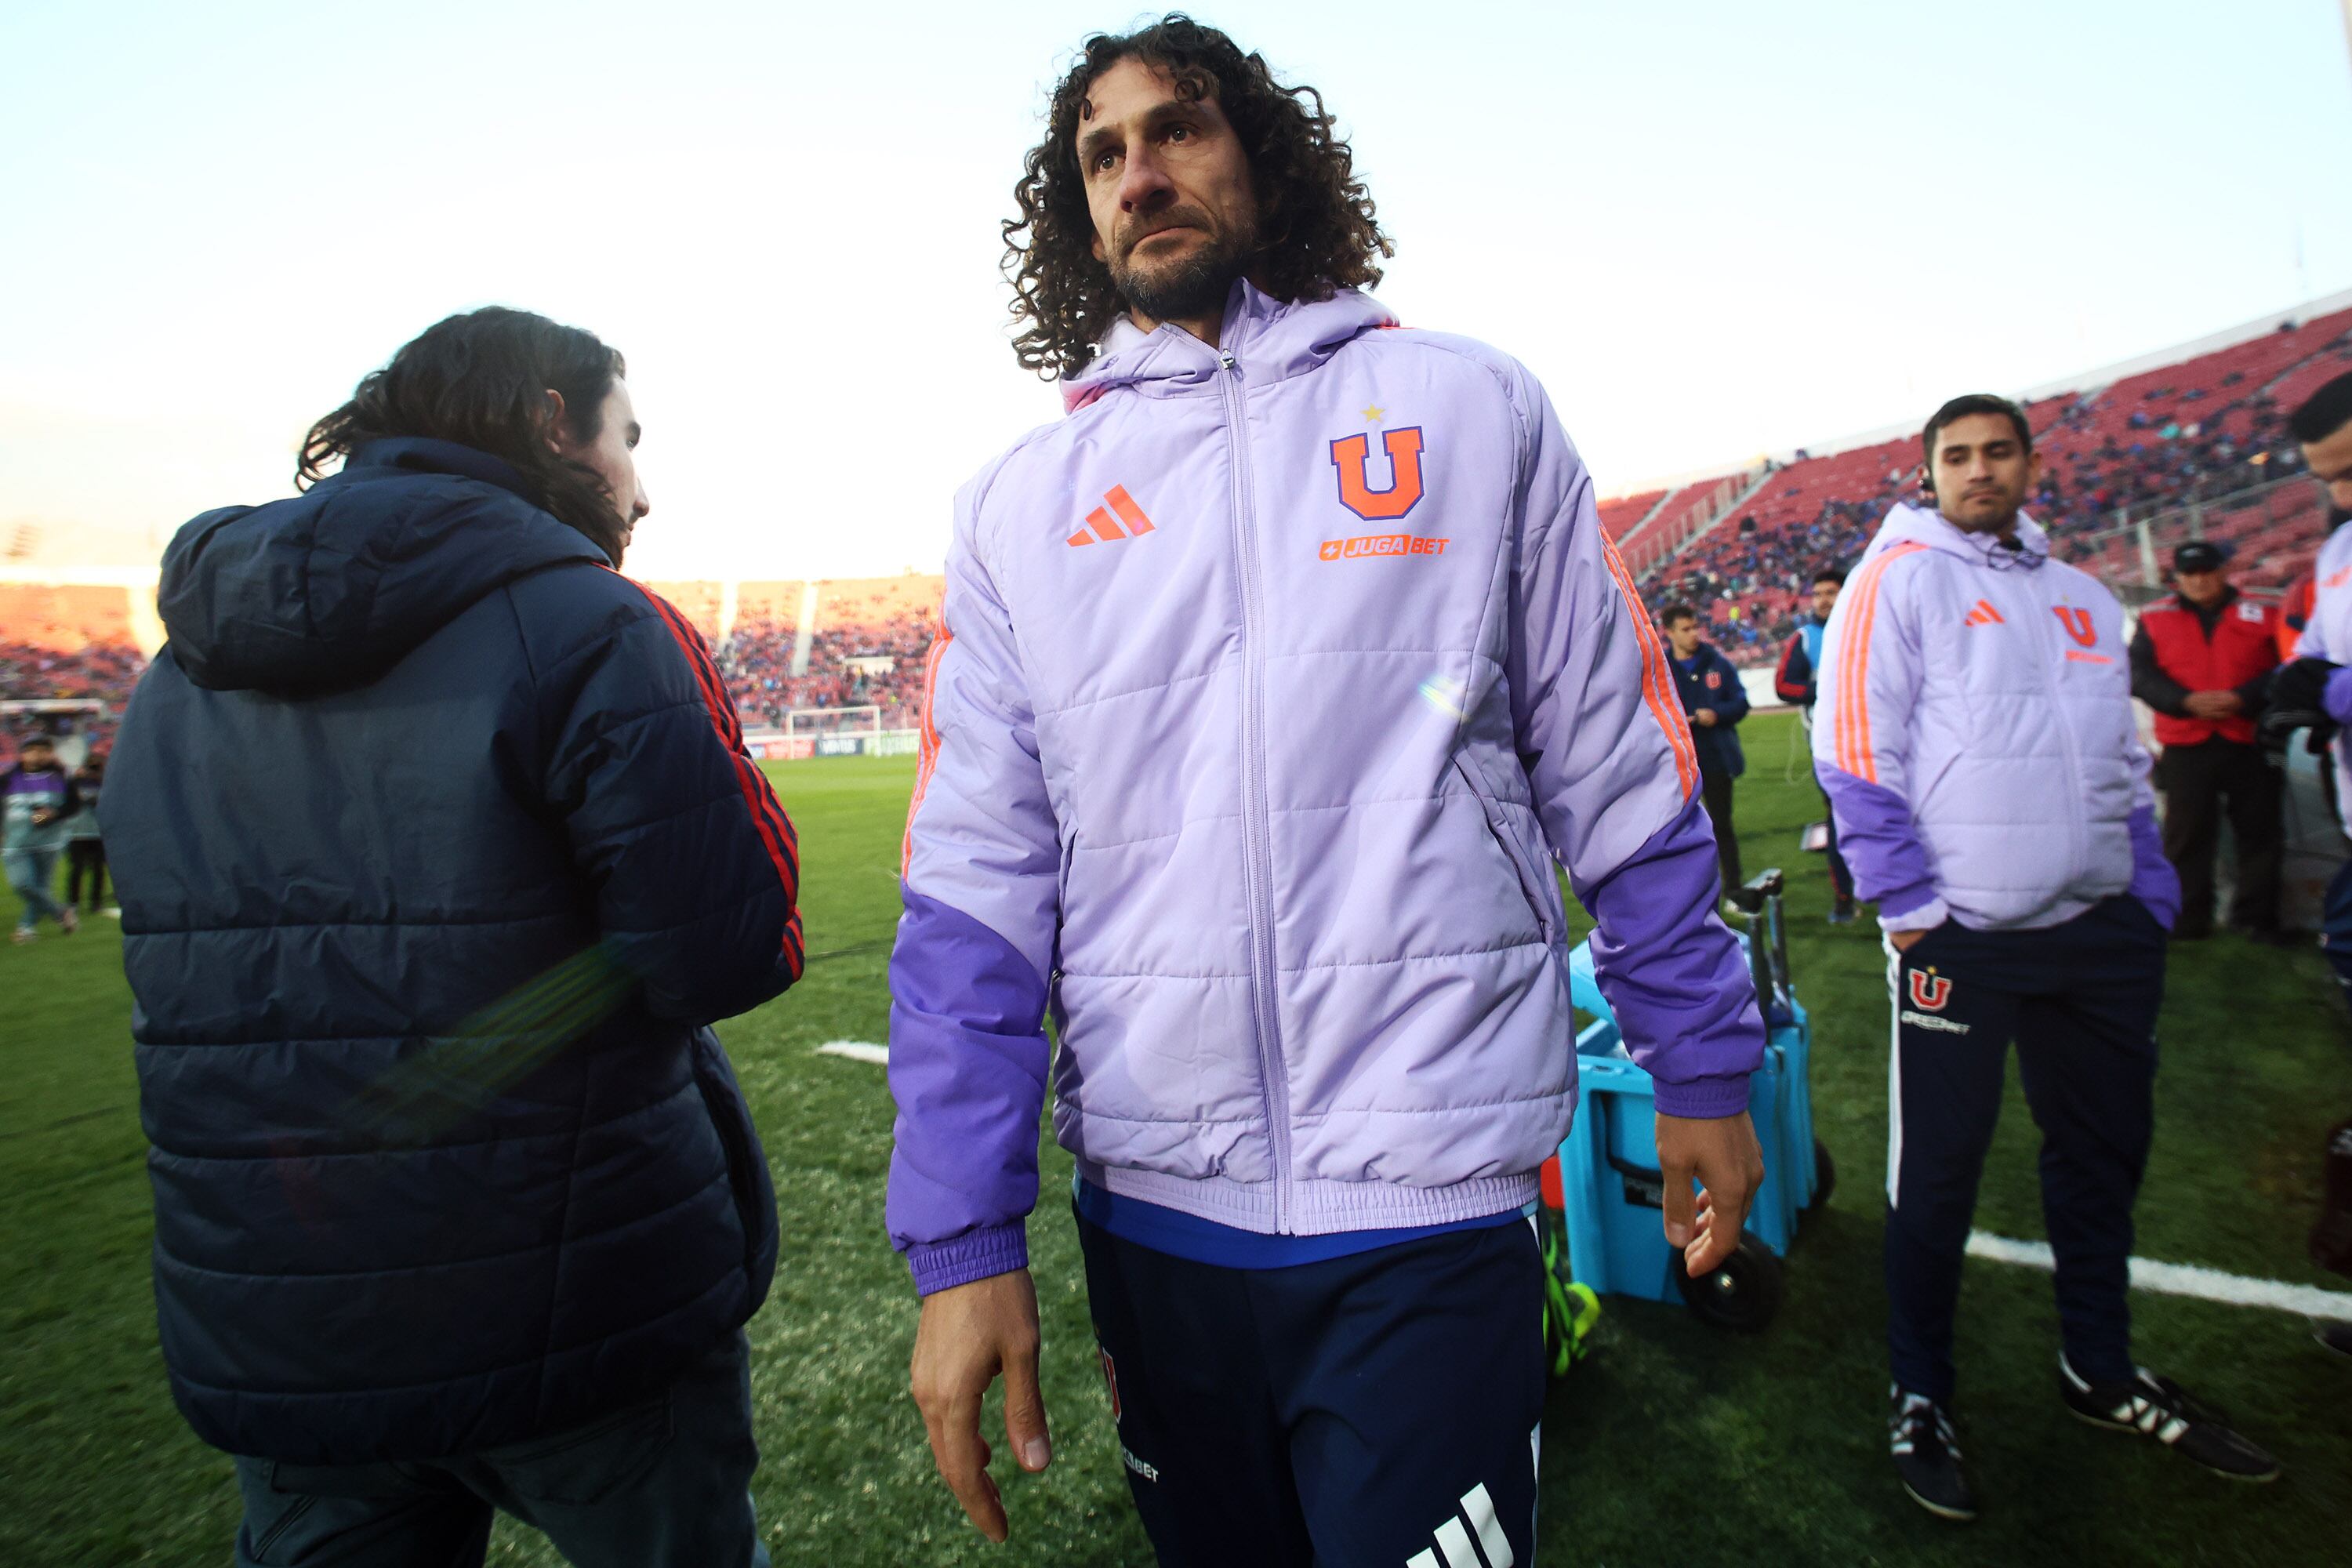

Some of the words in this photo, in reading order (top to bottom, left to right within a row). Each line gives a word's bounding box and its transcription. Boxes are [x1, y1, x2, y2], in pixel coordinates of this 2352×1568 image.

[1329, 426, 1425, 521] U
[2051, 605, 2098, 648] U
[1908, 967, 1952, 1011] U
